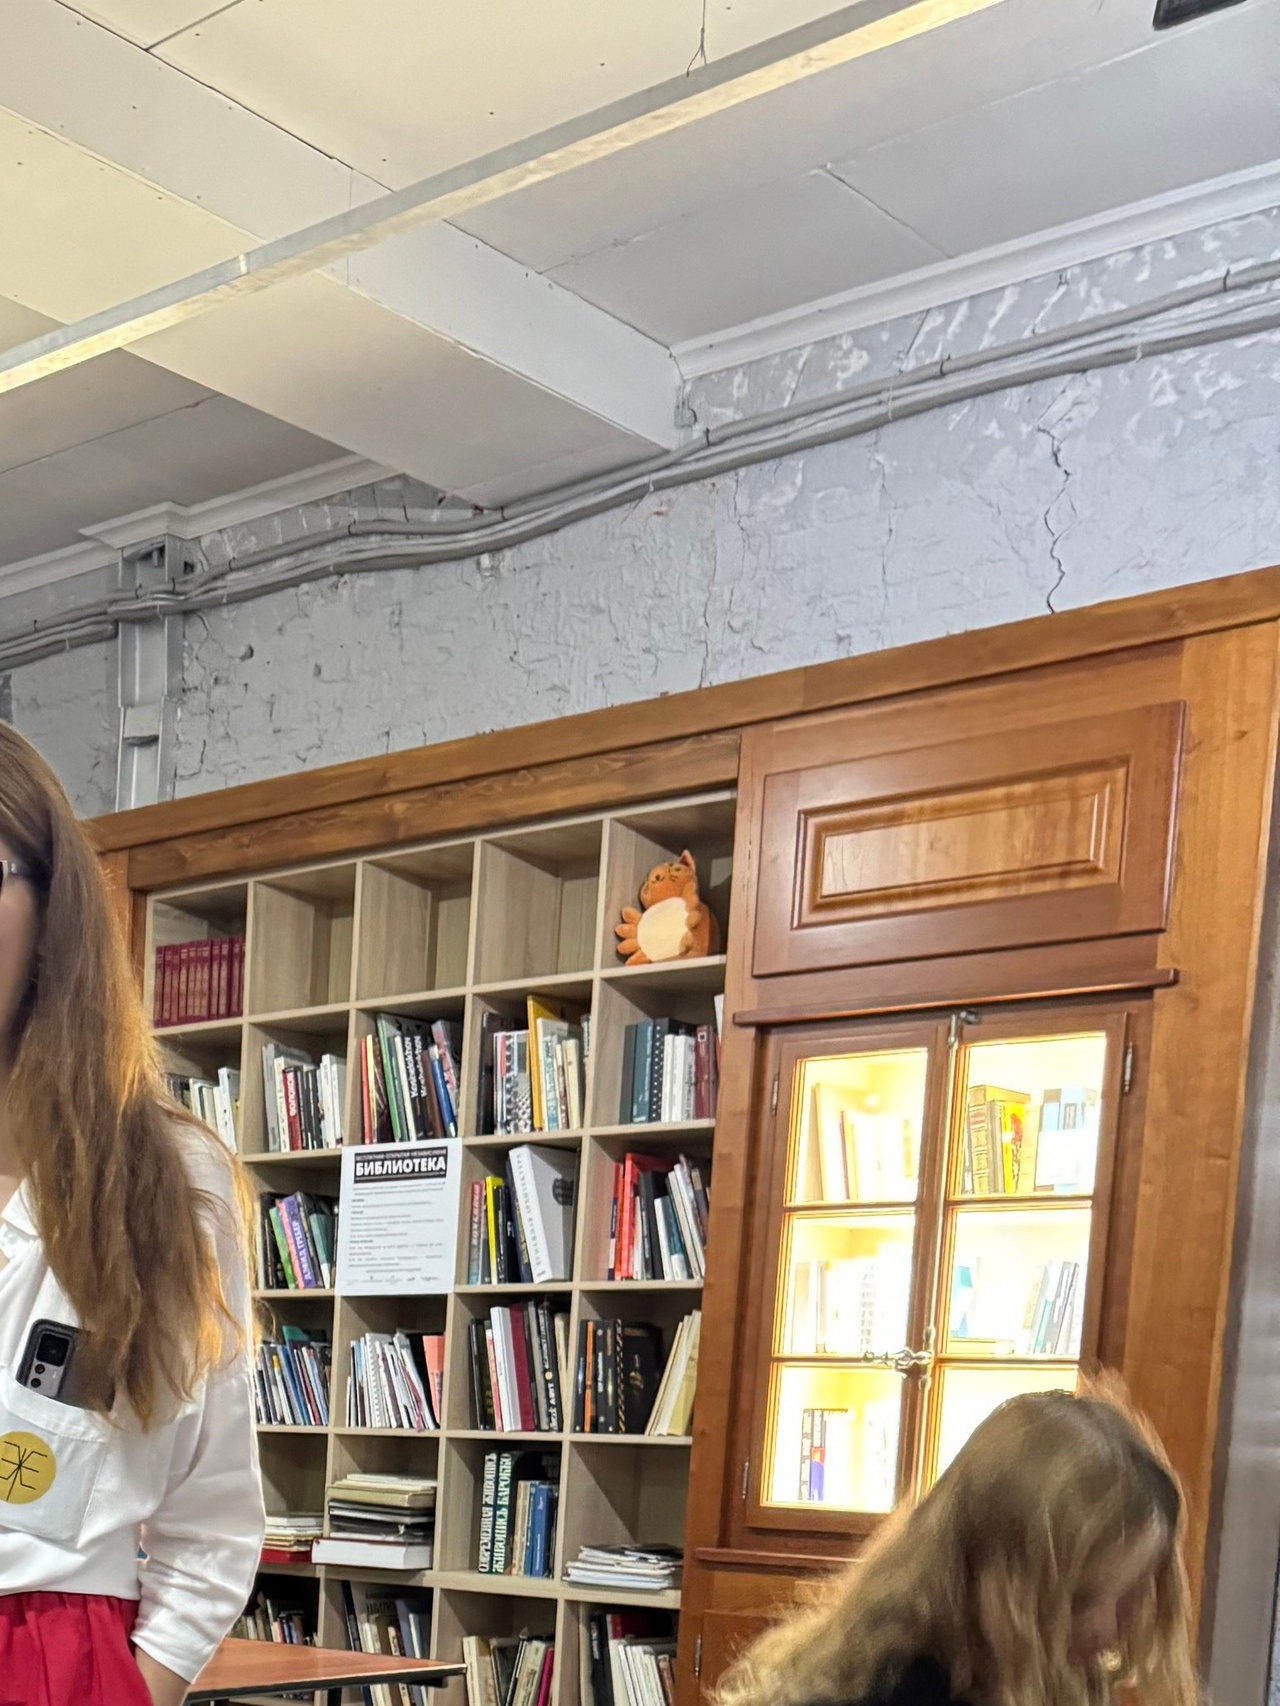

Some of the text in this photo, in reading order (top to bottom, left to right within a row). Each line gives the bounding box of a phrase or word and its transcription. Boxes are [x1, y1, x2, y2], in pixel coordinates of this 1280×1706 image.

[355, 1156, 446, 1176] БИБЛИОТЕКА
[483, 1452, 497, 1506] ЖИВОПИСЬ
[491, 1453, 512, 1573] ЖИВОПИСЬ БАРОККО
